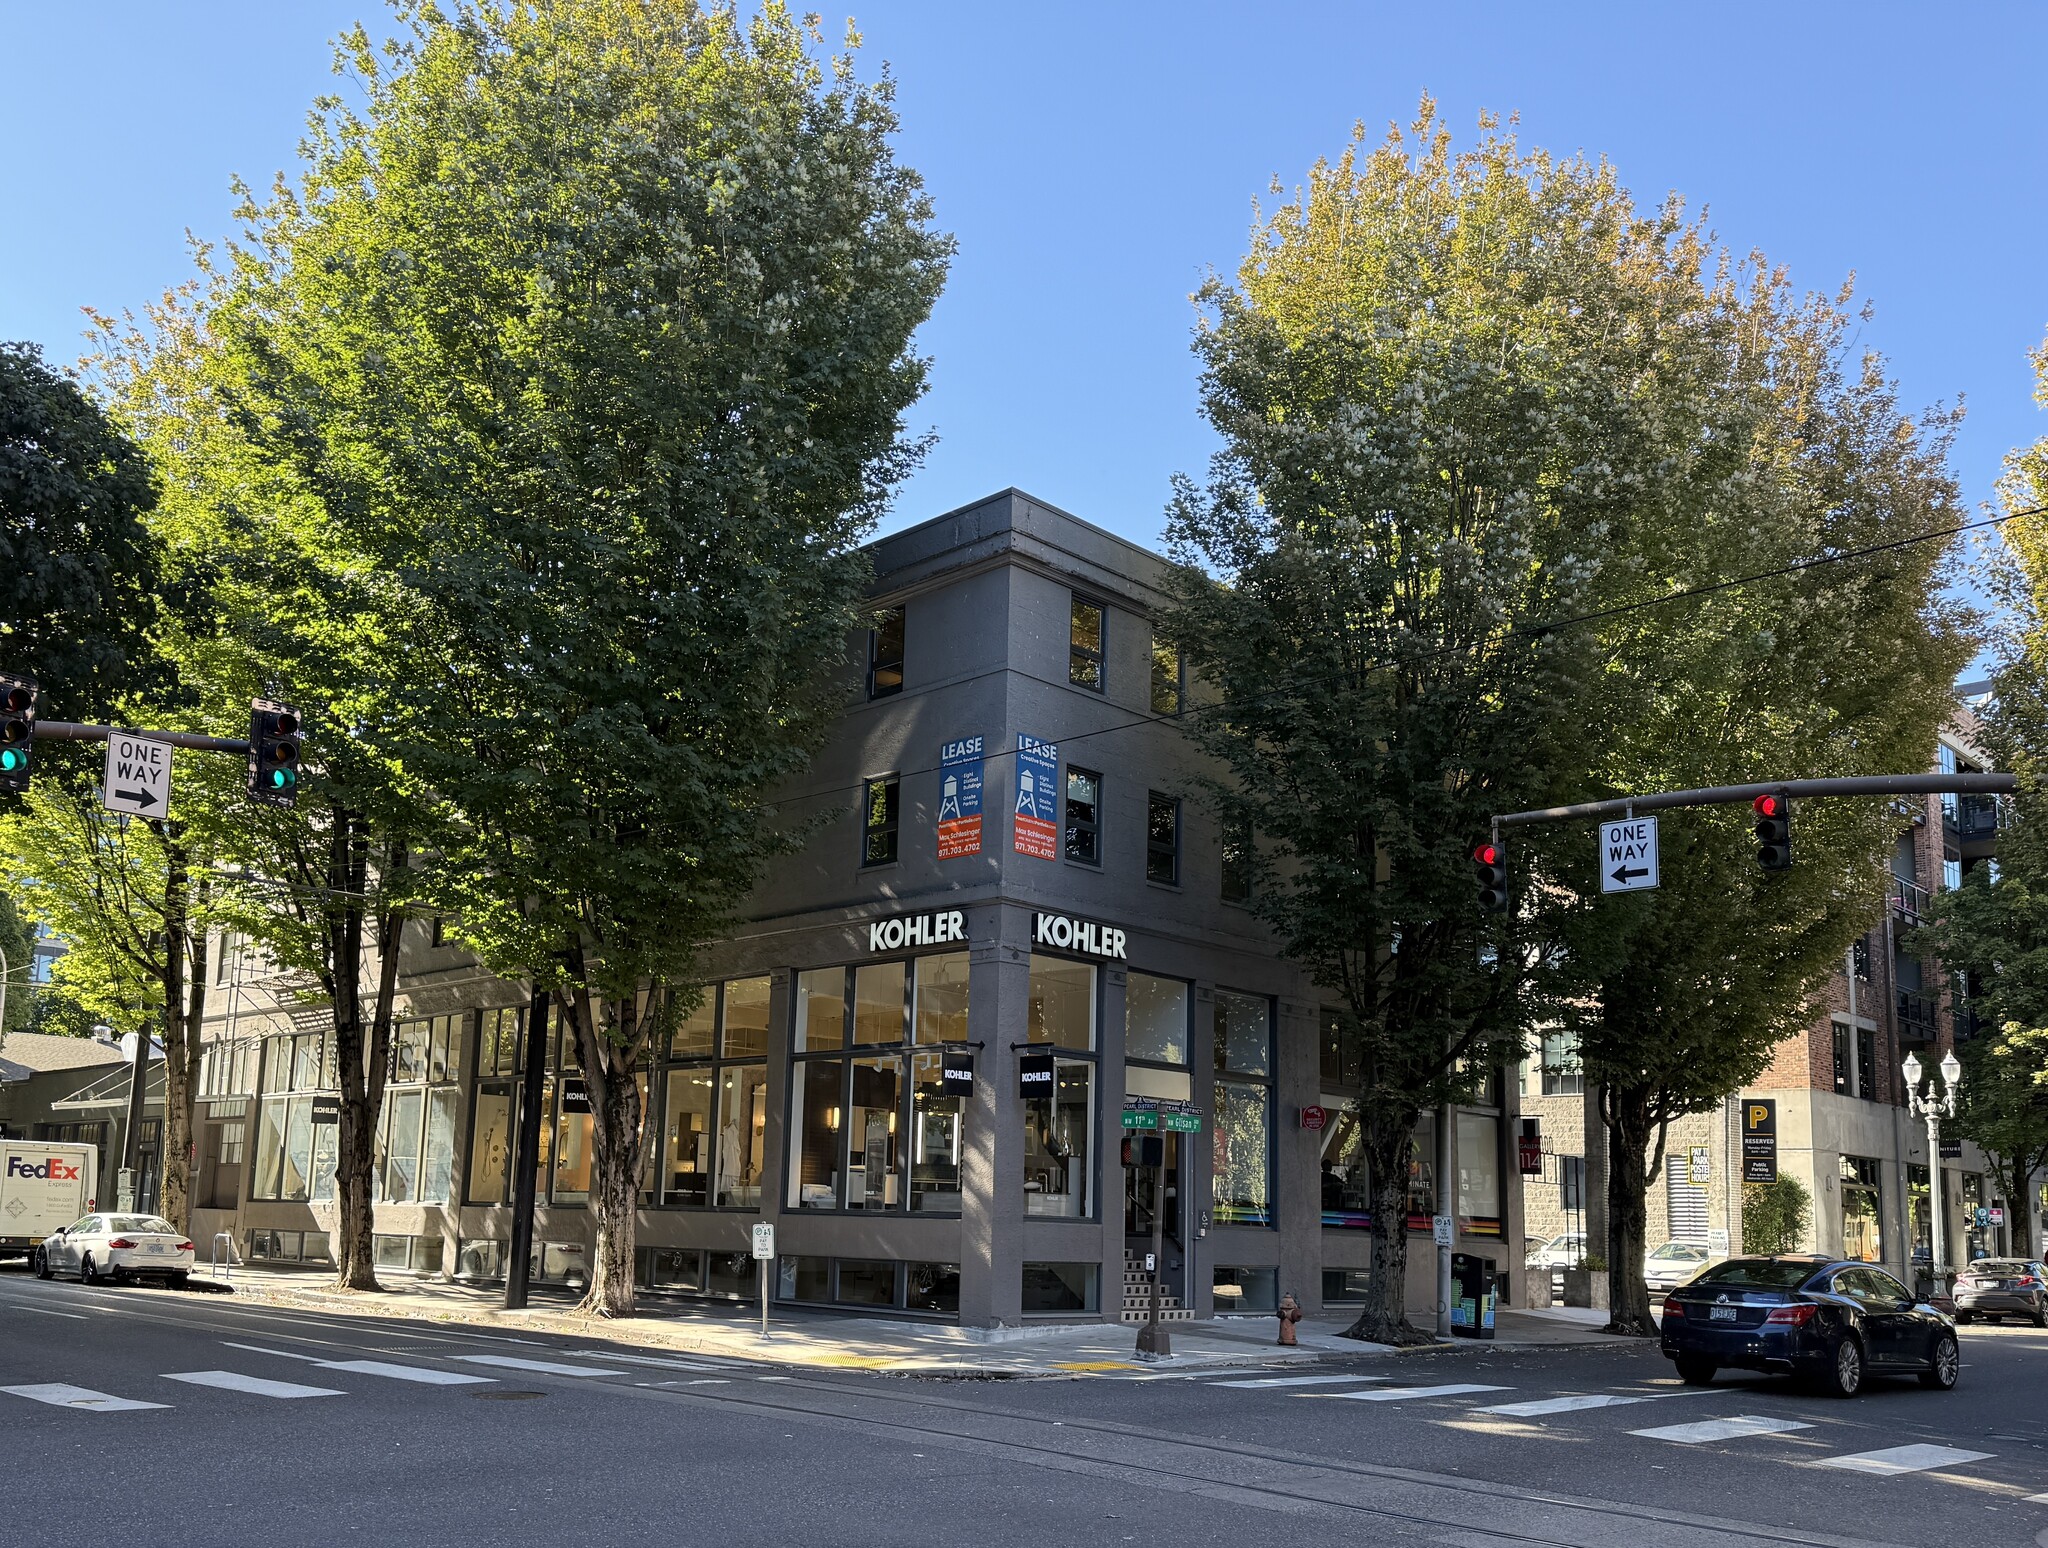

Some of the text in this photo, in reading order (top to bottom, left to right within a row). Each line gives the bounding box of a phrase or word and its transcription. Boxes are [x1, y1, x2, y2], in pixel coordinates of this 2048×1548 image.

[121, 742, 161, 764] ONE
[942, 737, 982, 760] LEASE
[1019, 736, 1056, 760] LEASE
[1021, 754, 1054, 769] Creative Spaces
[118, 761, 162, 784] WAY
[950, 828, 980, 838] Schlesinger
[1016, 827, 1026, 835] Max
[1028, 830, 1056, 843] Schlesinger
[1610, 824, 1646, 843] ONE
[938, 843, 980, 856] 971.703.4702
[1015, 842, 1054, 858] 971.703.4702
[1610, 842, 1648, 862] WAY
[870, 910, 964, 951] KOHLER
[1038, 912, 1126, 959] KOHLER
[945, 1070, 972, 1081] KOHLER
[1022, 1072, 1051, 1082] KOHLER
[314, 1106, 338, 1114] KOHLER
[1750, 1106, 1768, 1129] P
[1175, 1118, 1192, 1128] Glisan
[1691, 1147, 1701, 1156] PAY
[8, 1156, 80, 1180] FedEx
[1520, 1153, 1541, 1168] 114
